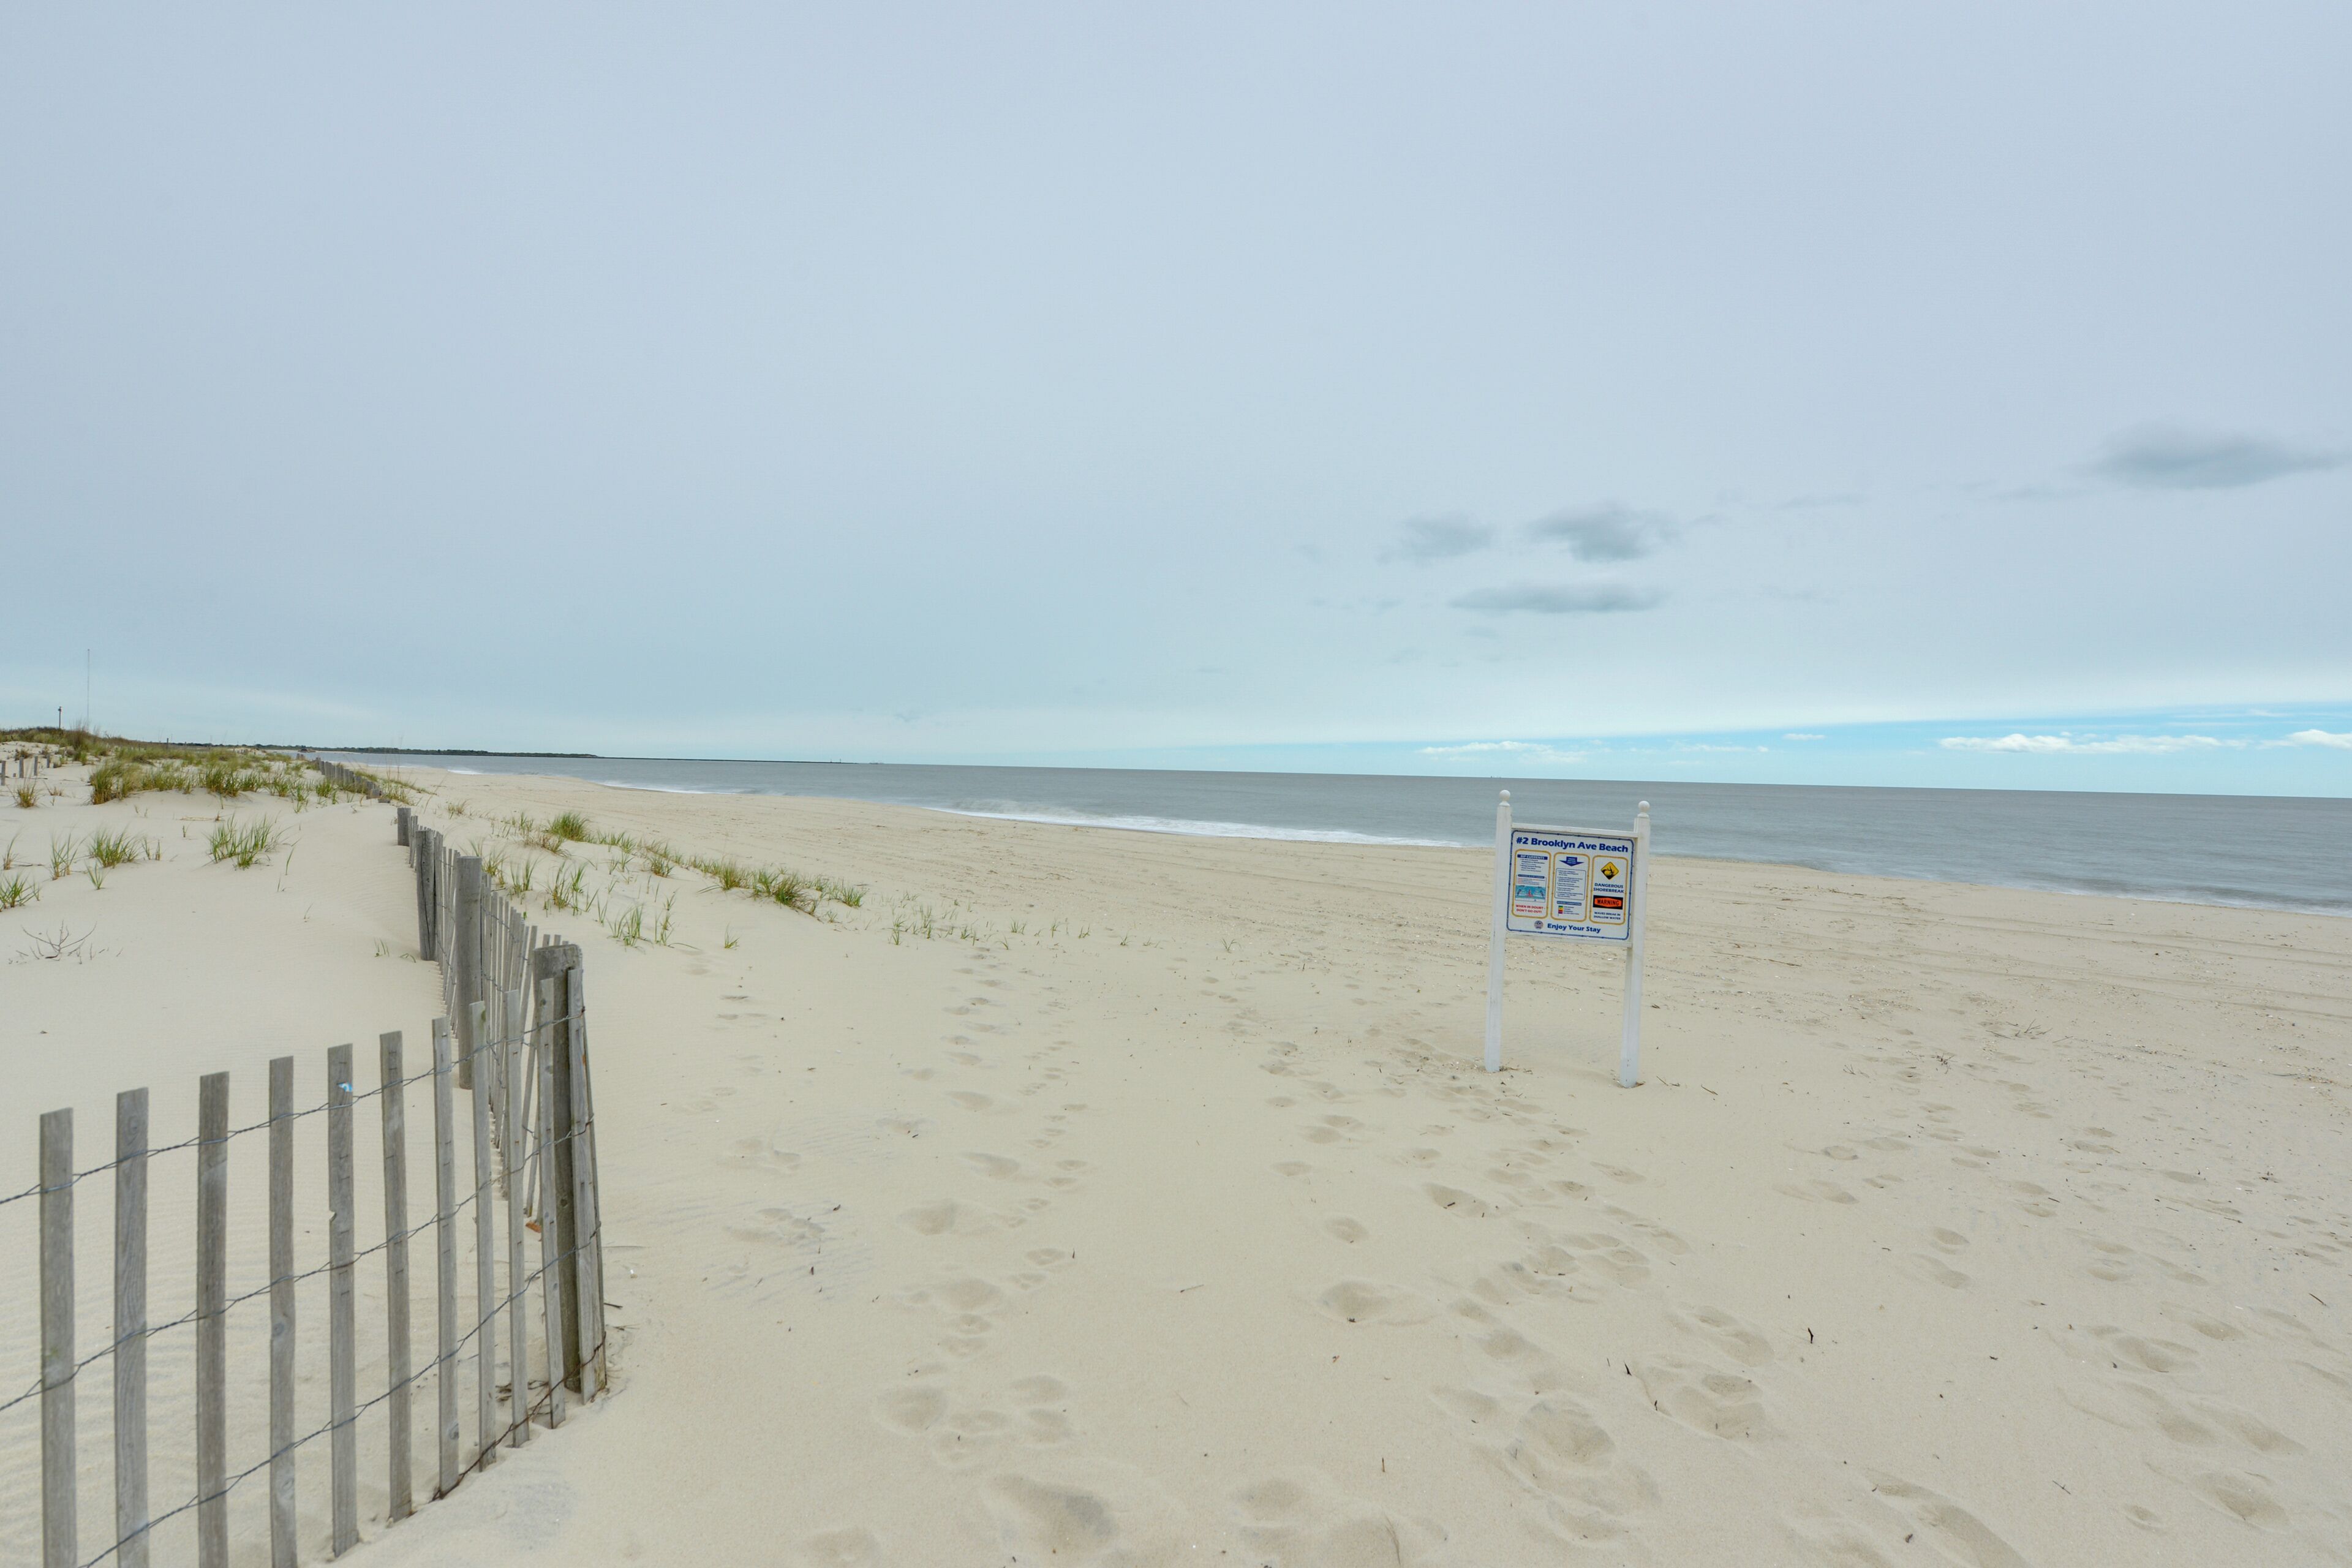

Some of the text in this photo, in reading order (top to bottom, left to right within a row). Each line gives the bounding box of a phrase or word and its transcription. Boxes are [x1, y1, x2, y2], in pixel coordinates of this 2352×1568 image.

[1531, 838, 1575, 849] Brooklyn
[1577, 842, 1597, 850] Ave
[1599, 843, 1629, 853] Beach
